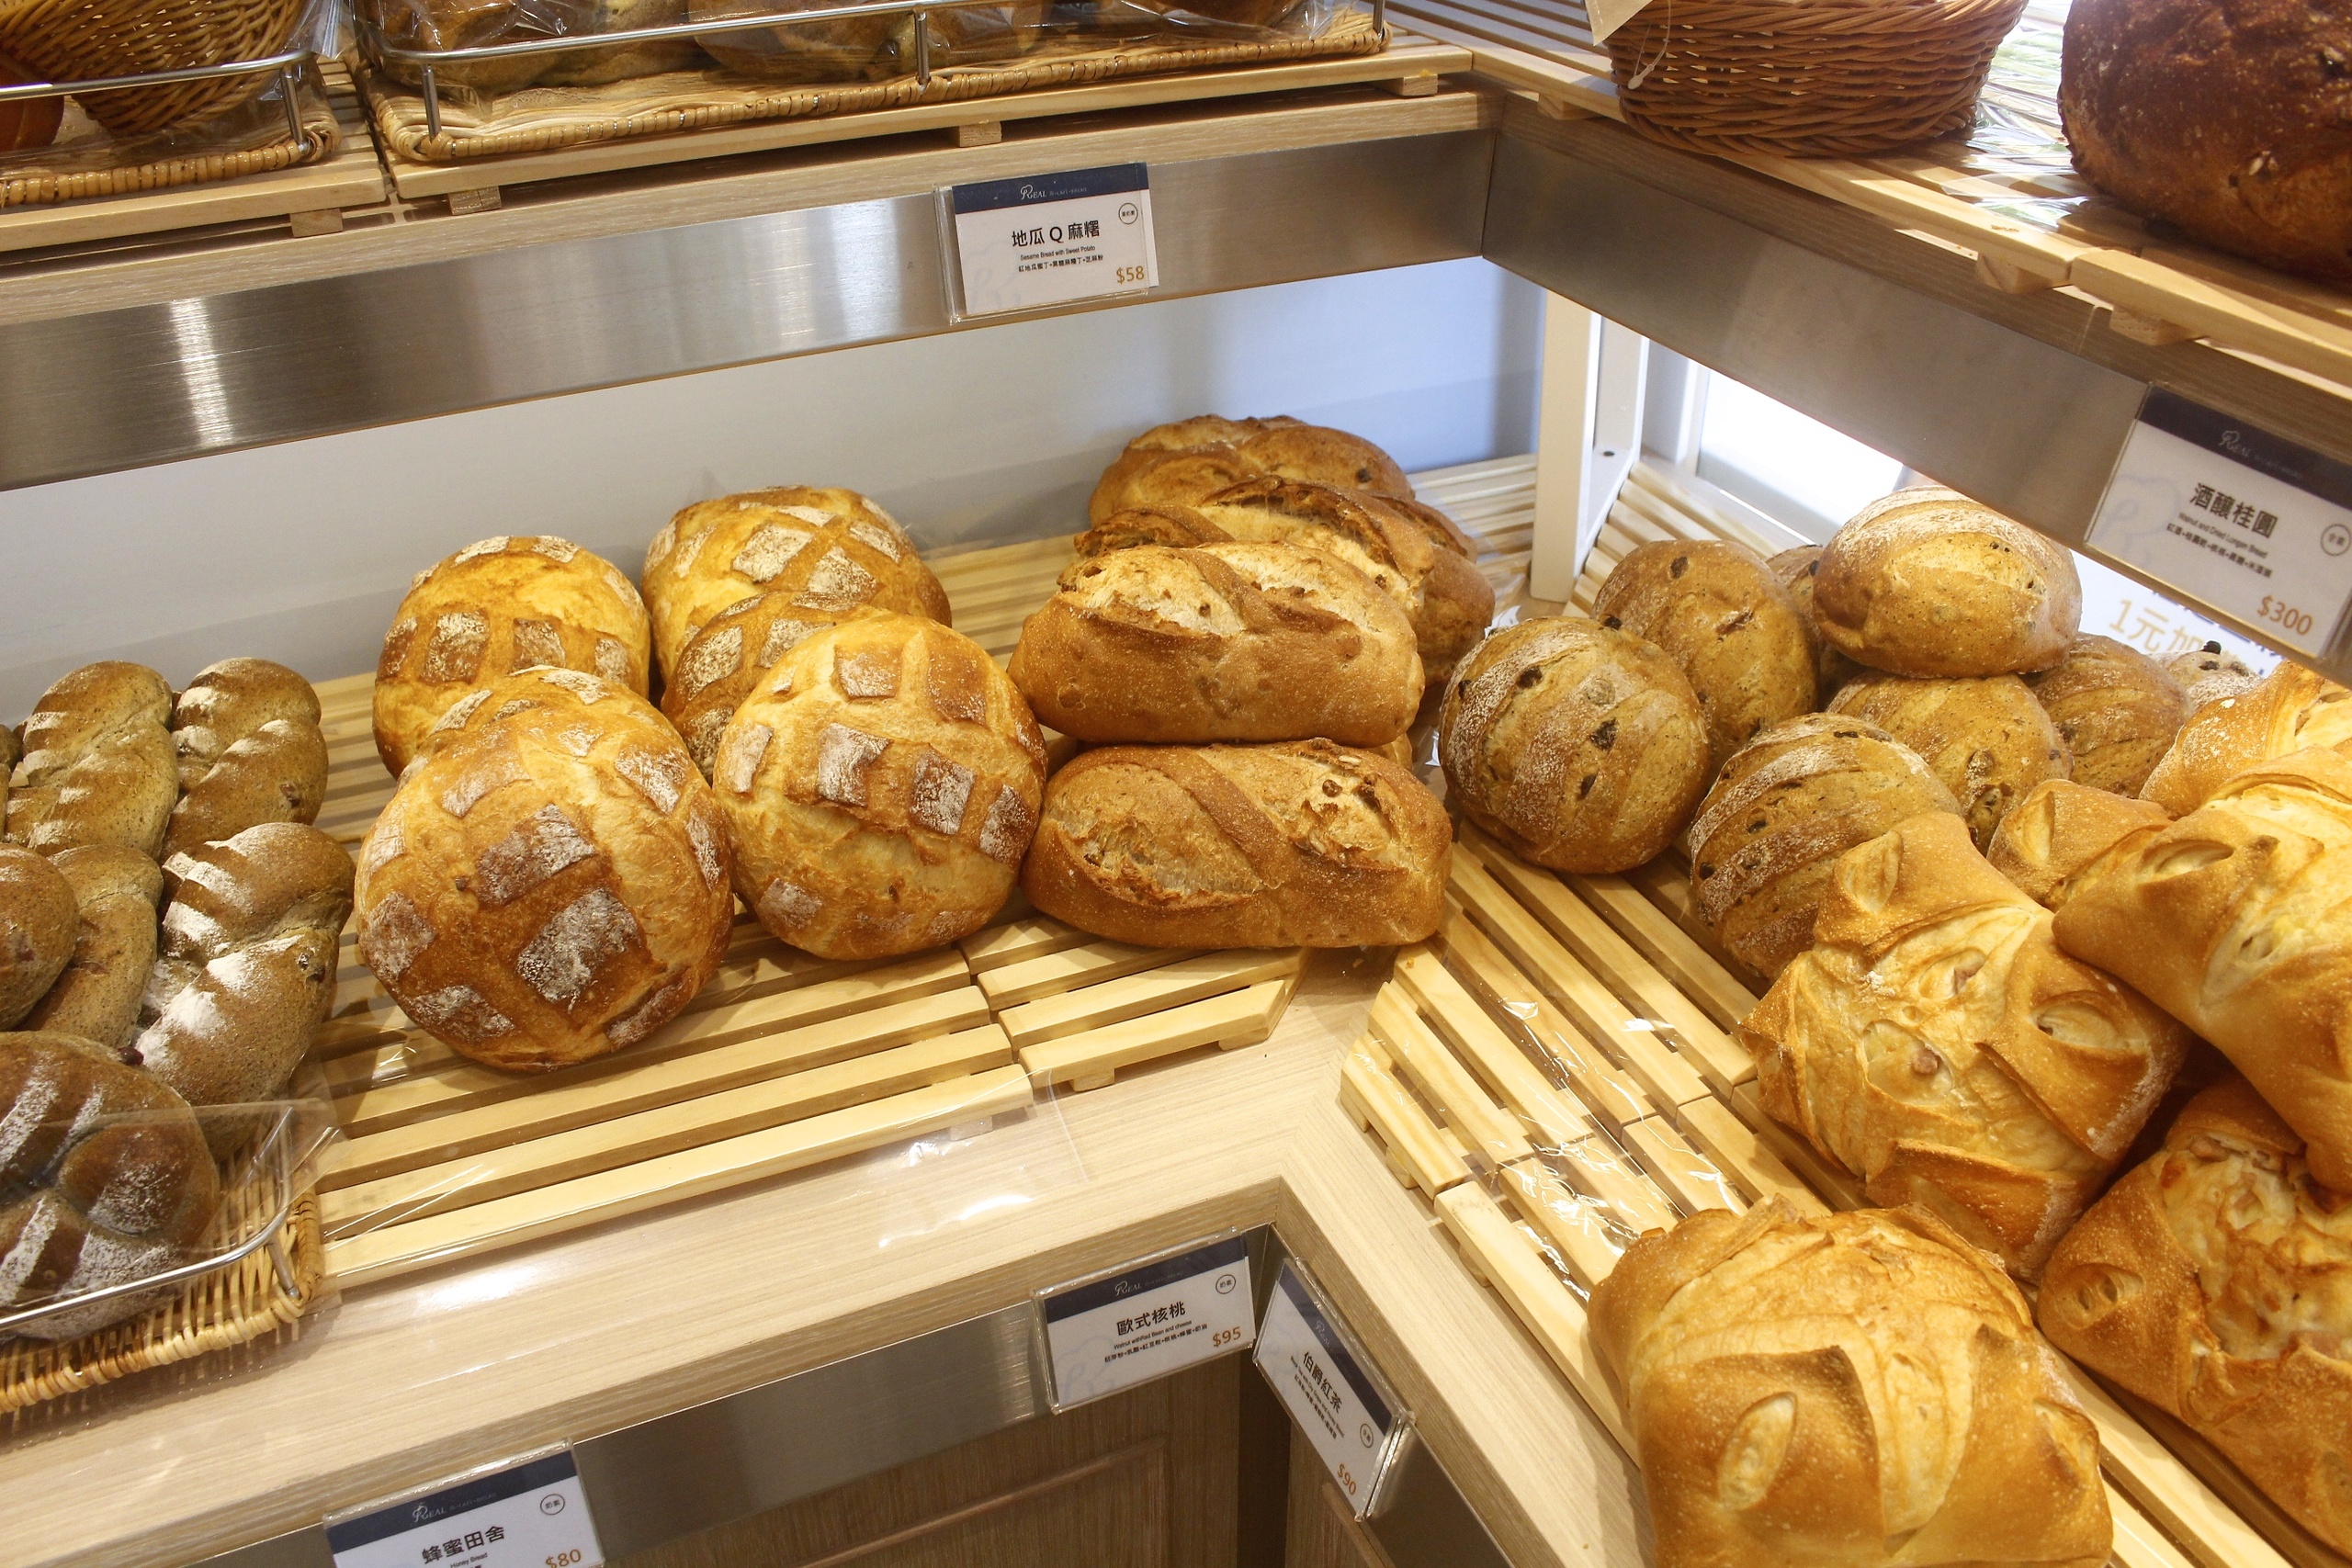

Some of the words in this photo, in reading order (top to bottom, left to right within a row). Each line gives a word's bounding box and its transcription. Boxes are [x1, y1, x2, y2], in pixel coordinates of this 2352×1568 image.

[1012, 228, 1045, 246] 地瓜
[1050, 227, 1063, 243] Q
[1069, 220, 1099, 240] 麻糬
[1116, 265, 1144, 284] $58
[2190, 483, 2278, 538] 酒釀桂圓
[2257, 595, 2312, 636] $300
[1116, 1302, 1185, 1336] 歐式核桃
[1114, 1340, 1130, 1349] Walnut
[1213, 1326, 1240, 1348] $95
[1304, 1352, 1341, 1413] 伯爵紅茶
[1338, 1464, 1356, 1495] $90
[422, 1526, 504, 1564] 蜂蜜田舍
[545, 1549, 582, 1568] $80
